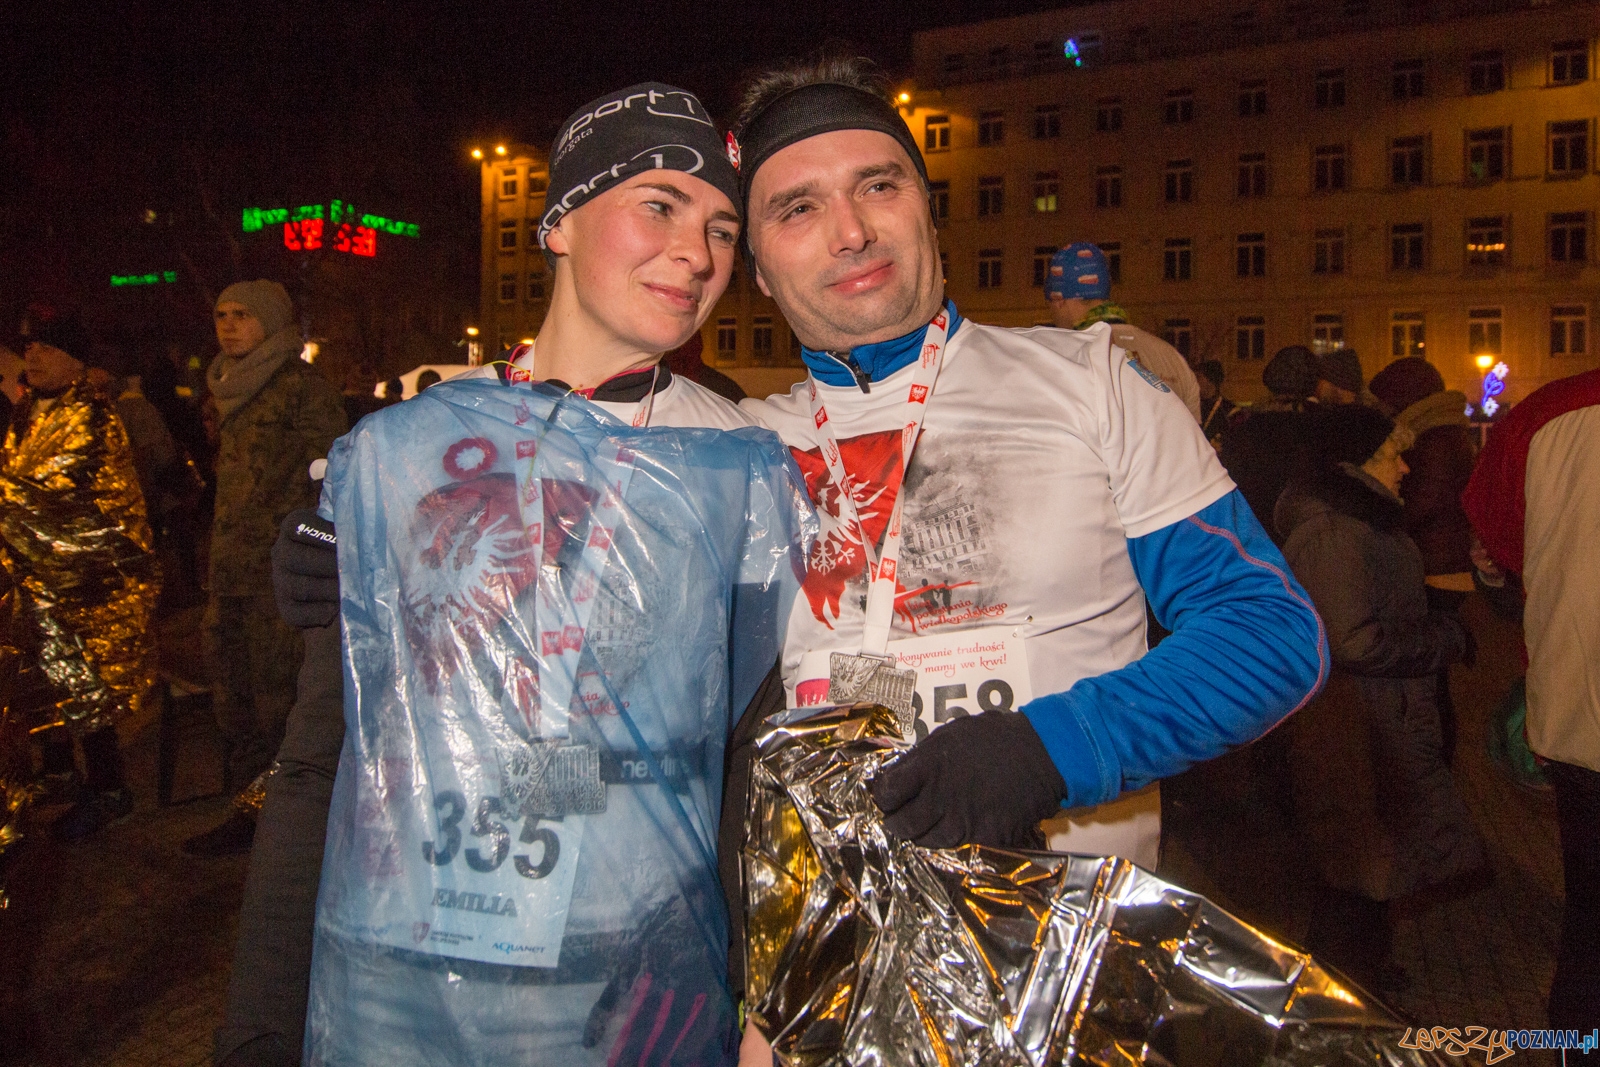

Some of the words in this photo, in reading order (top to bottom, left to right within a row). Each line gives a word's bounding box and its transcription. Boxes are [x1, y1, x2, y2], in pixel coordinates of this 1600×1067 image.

[303, 526, 337, 544] TOUCH
[916, 600, 973, 624] powstania
[919, 602, 1008, 630] wielkopolskiego
[957, 641, 1005, 655] trudności
[925, 663, 956, 678] mamy
[961, 661, 975, 669] we
[979, 653, 1007, 671] krwi!
[422, 790, 561, 880] 355
[431, 888, 518, 918] EMILIA
